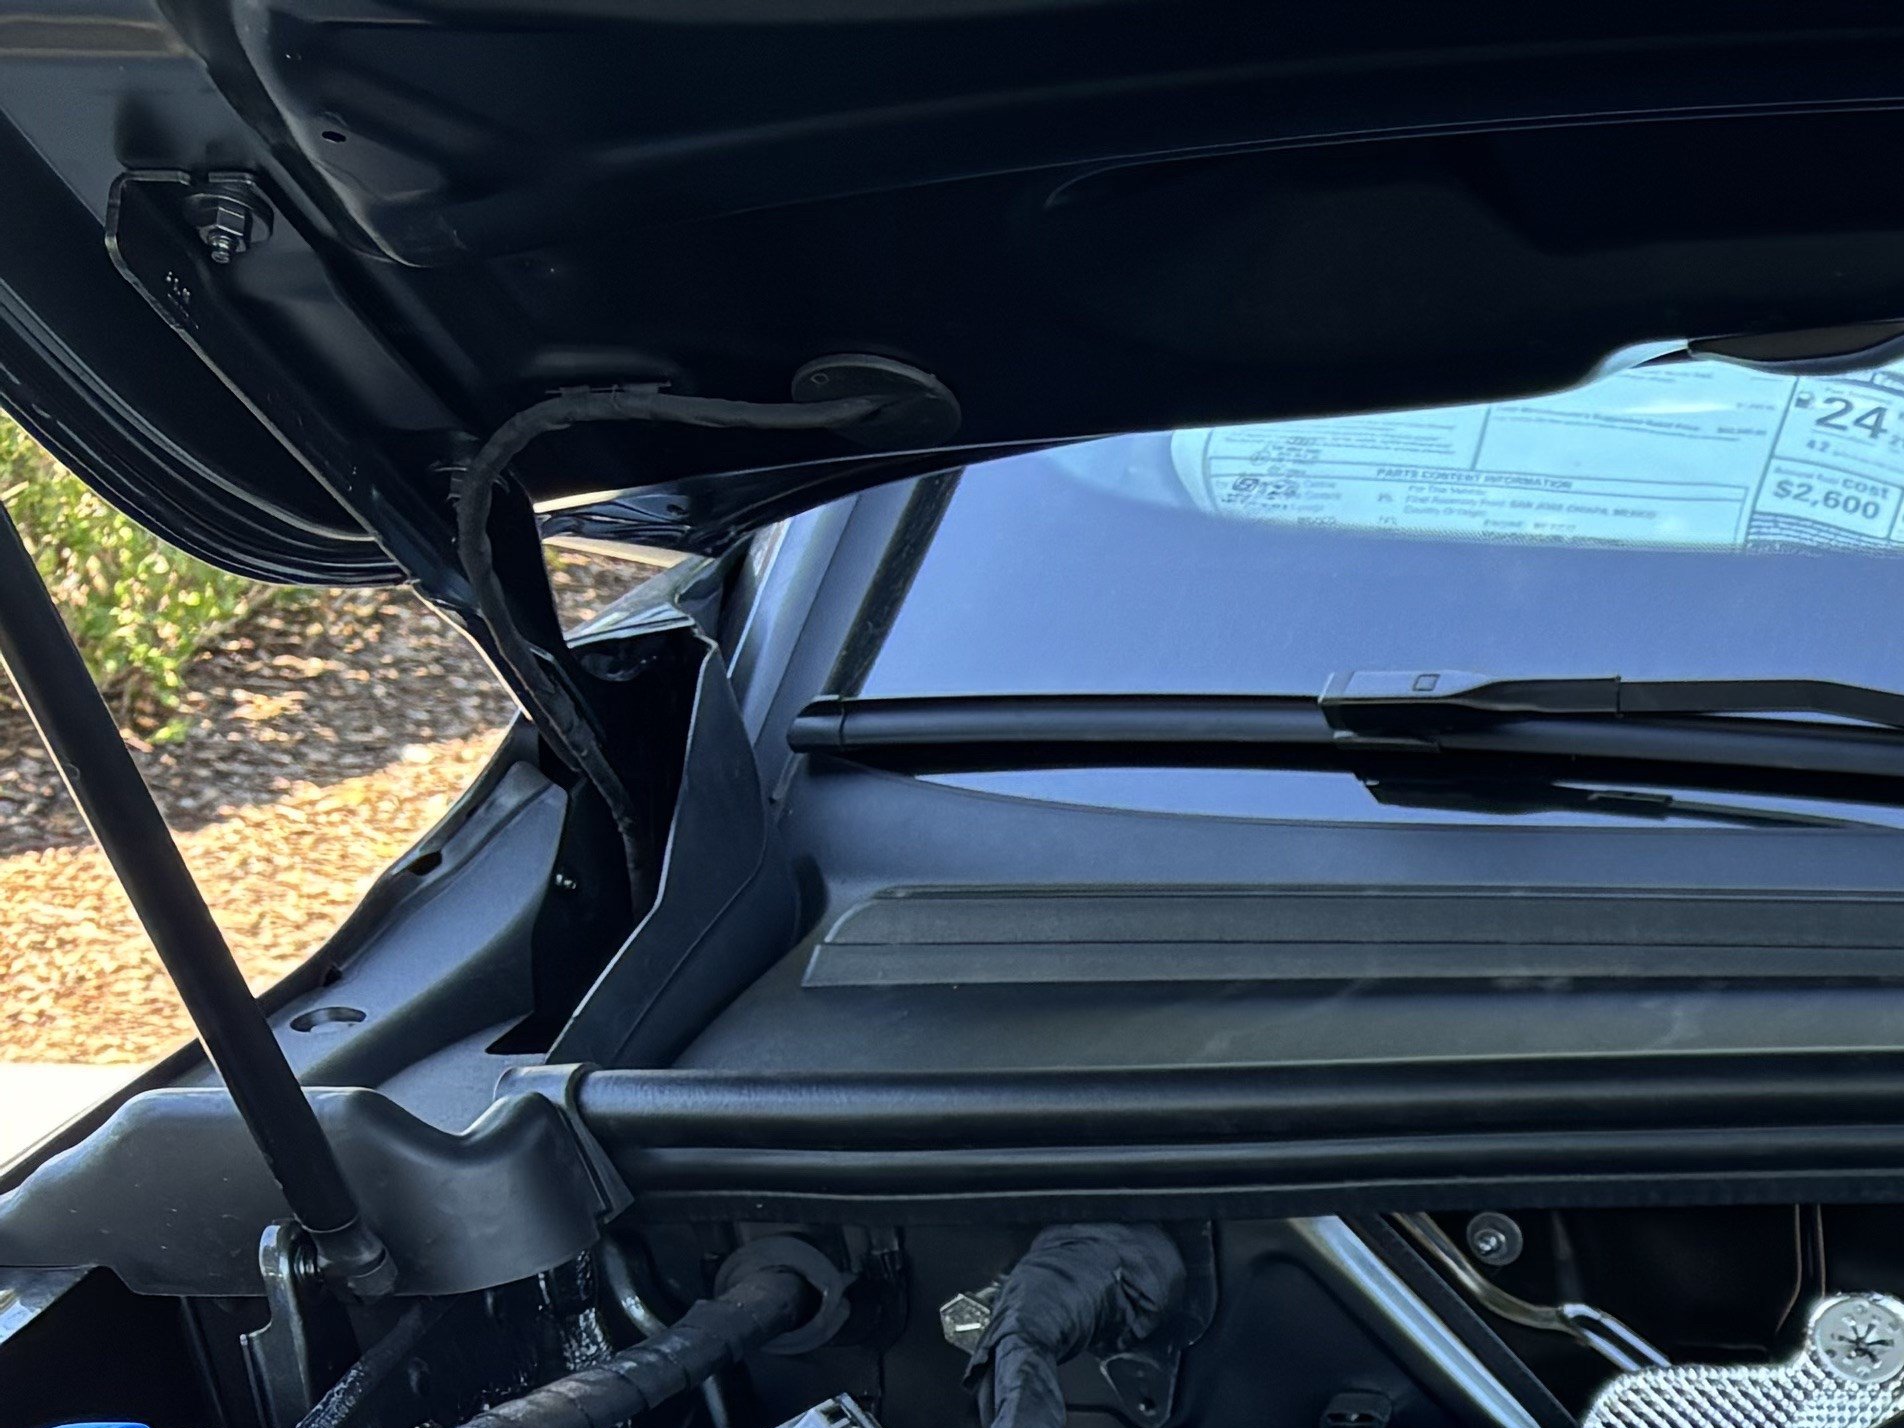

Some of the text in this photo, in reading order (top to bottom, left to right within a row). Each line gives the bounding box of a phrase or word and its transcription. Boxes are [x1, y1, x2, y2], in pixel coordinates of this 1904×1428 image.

[1815, 396, 1889, 438] 24
[1422, 470, 1480, 482] CONTENT
[1484, 475, 1572, 489] INFORMATION
[1842, 477, 1889, 498] cost
[1773, 479, 1880, 519] $2,600
